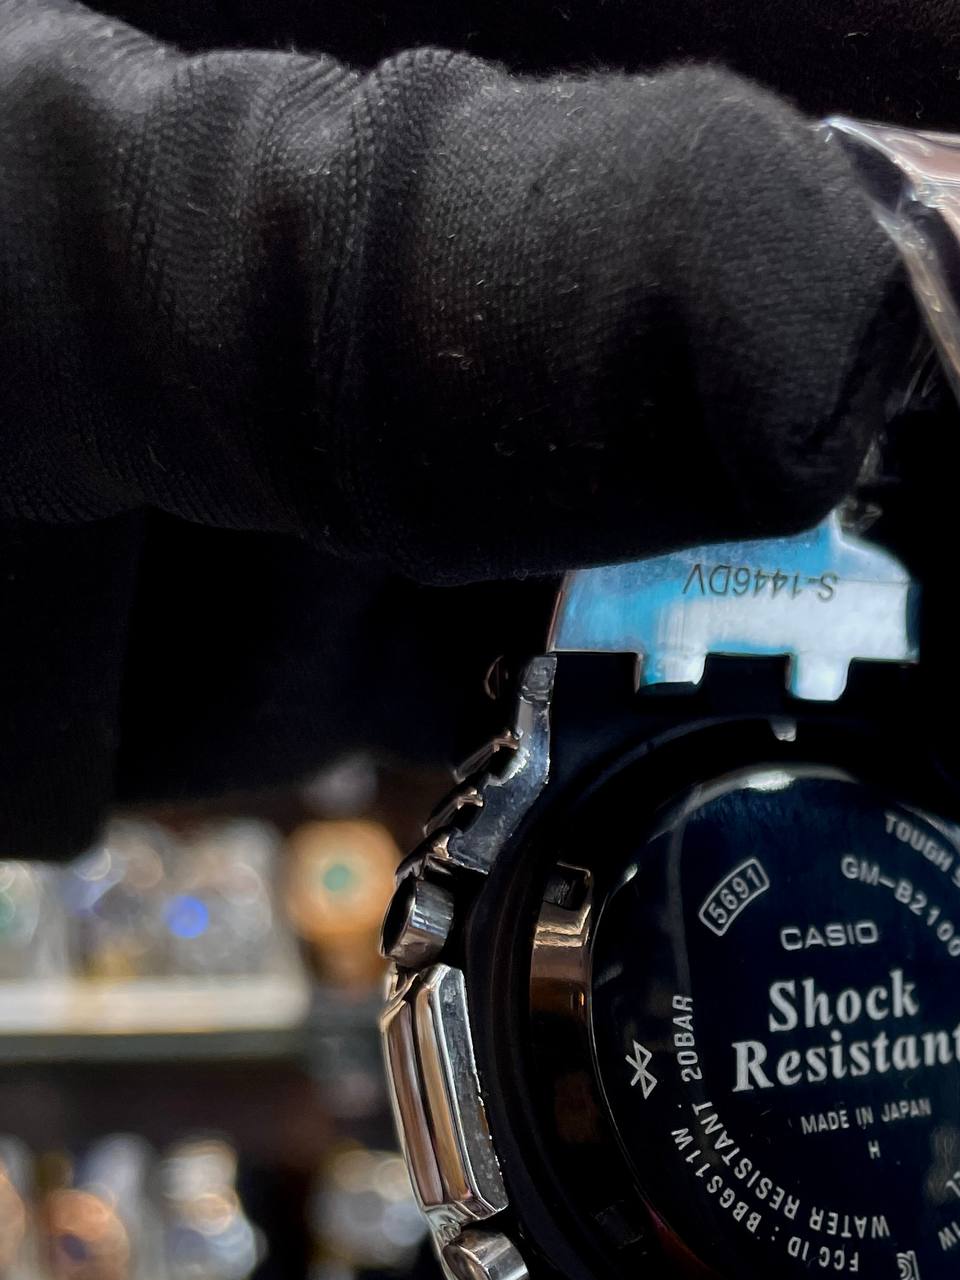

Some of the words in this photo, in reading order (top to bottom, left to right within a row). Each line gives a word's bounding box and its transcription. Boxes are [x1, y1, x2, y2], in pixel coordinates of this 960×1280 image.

[682, 563, 840, 602] S-1446DV
[884, 811, 954, 872] TOUGH
[707, 862, 763, 926] 5691
[780, 919, 879, 951] CASIO
[768, 968, 920, 1033] Shock
[672, 994, 703, 1083] 20BAR
[800, 1109, 850, 1135] MADE
[855, 1105, 874, 1127] IN
[881, 1097, 932, 1122] JAPAN
[692, 1101, 801, 1220] RESISTANT
[868, 1141, 881, 1160] H
[671, 1127, 763, 1234] BBGS11W
[809, 1206, 891, 1239] WATER
[786, 1235, 811, 1262] ID
[818, 1246, 860, 1273] FCC
